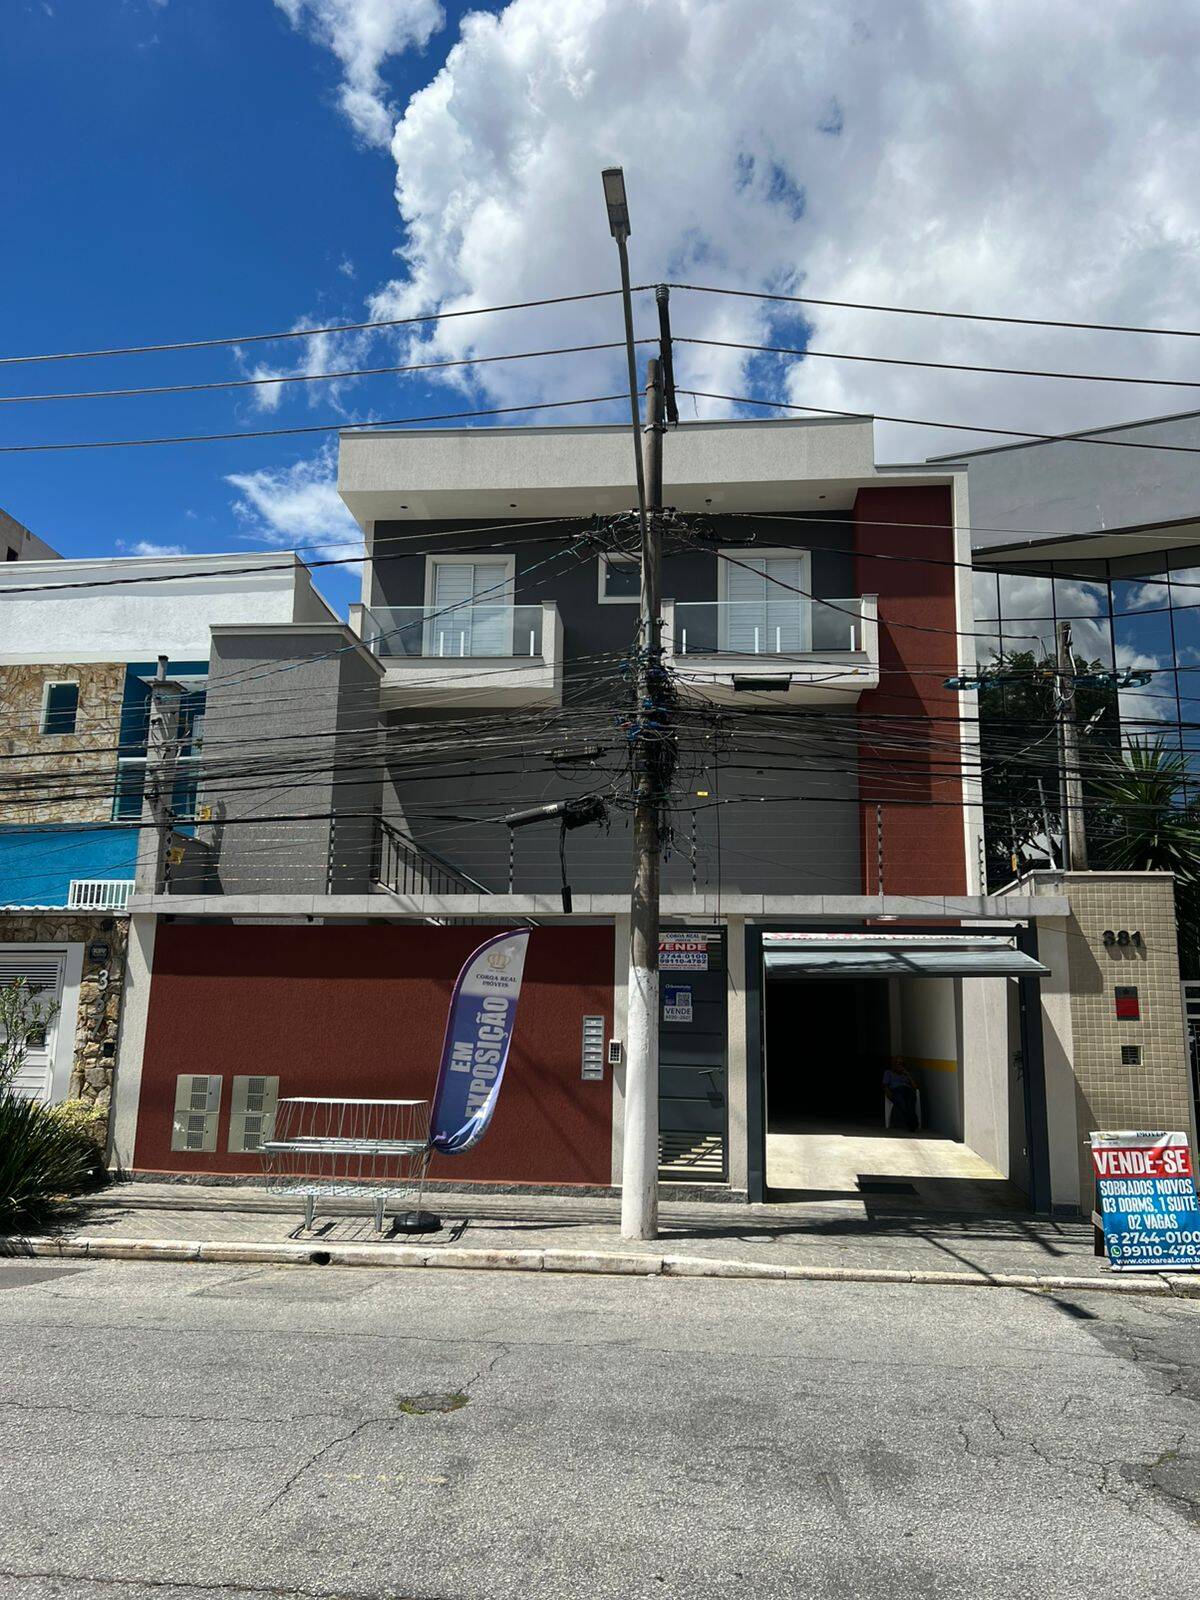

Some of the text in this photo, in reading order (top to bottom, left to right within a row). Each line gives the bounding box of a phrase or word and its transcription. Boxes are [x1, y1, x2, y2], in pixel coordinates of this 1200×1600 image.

[1103, 930, 1141, 947] 381
[476, 973, 498, 981] COROA
[665, 1007, 692, 1015] VENDE
[450, 1041, 474, 1073] EM
[465, 996, 509, 1118] EXPOSIÇÃO
[1093, 1149, 1189, 1174] VENDE-SE
[1100, 1179, 1194, 1196] SOBRADOS NOVOS
[1102, 1197, 1117, 1213] 03
[1119, 1197, 1158, 1213] DORMS,
[1158, 1196, 1166, 1212] 1
[1127, 1213, 1178, 1229] 02 VAGAS
[1121, 1230, 1200, 1244] 2744-0100
